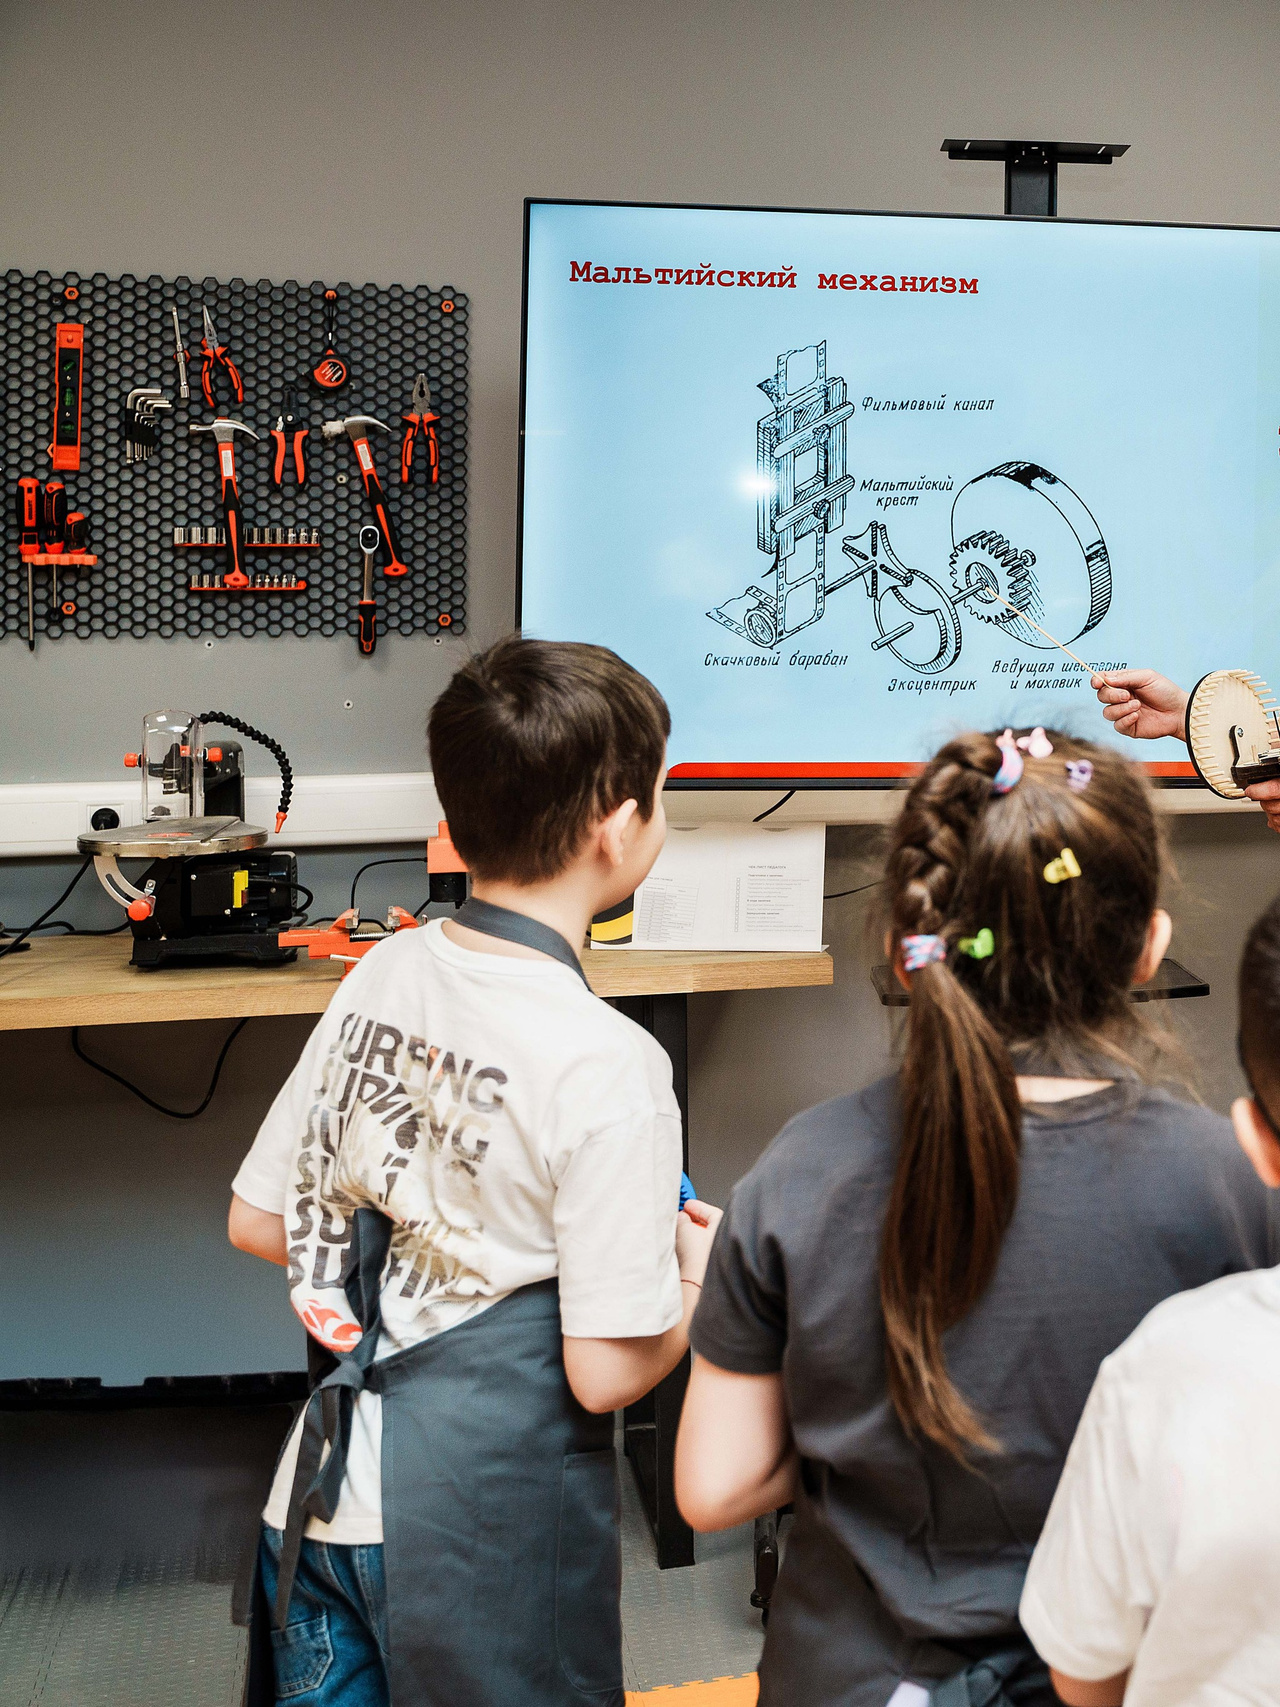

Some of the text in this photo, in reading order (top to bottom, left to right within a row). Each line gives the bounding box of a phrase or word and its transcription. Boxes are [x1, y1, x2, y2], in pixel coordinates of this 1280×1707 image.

[569, 261, 980, 295] Мальтийский механизм
[861, 394, 995, 411] Фильмовый канал
[860, 475, 954, 492] Мальтийский
[876, 496, 919, 511] крест
[704, 650, 849, 670] Скачковый барабан
[992, 658, 1055, 677] Ведущая
[888, 678, 978, 696] Эксцентрик
[1010, 678, 1082, 690] и маховик
[329, 1013, 509, 1113] SURFING
